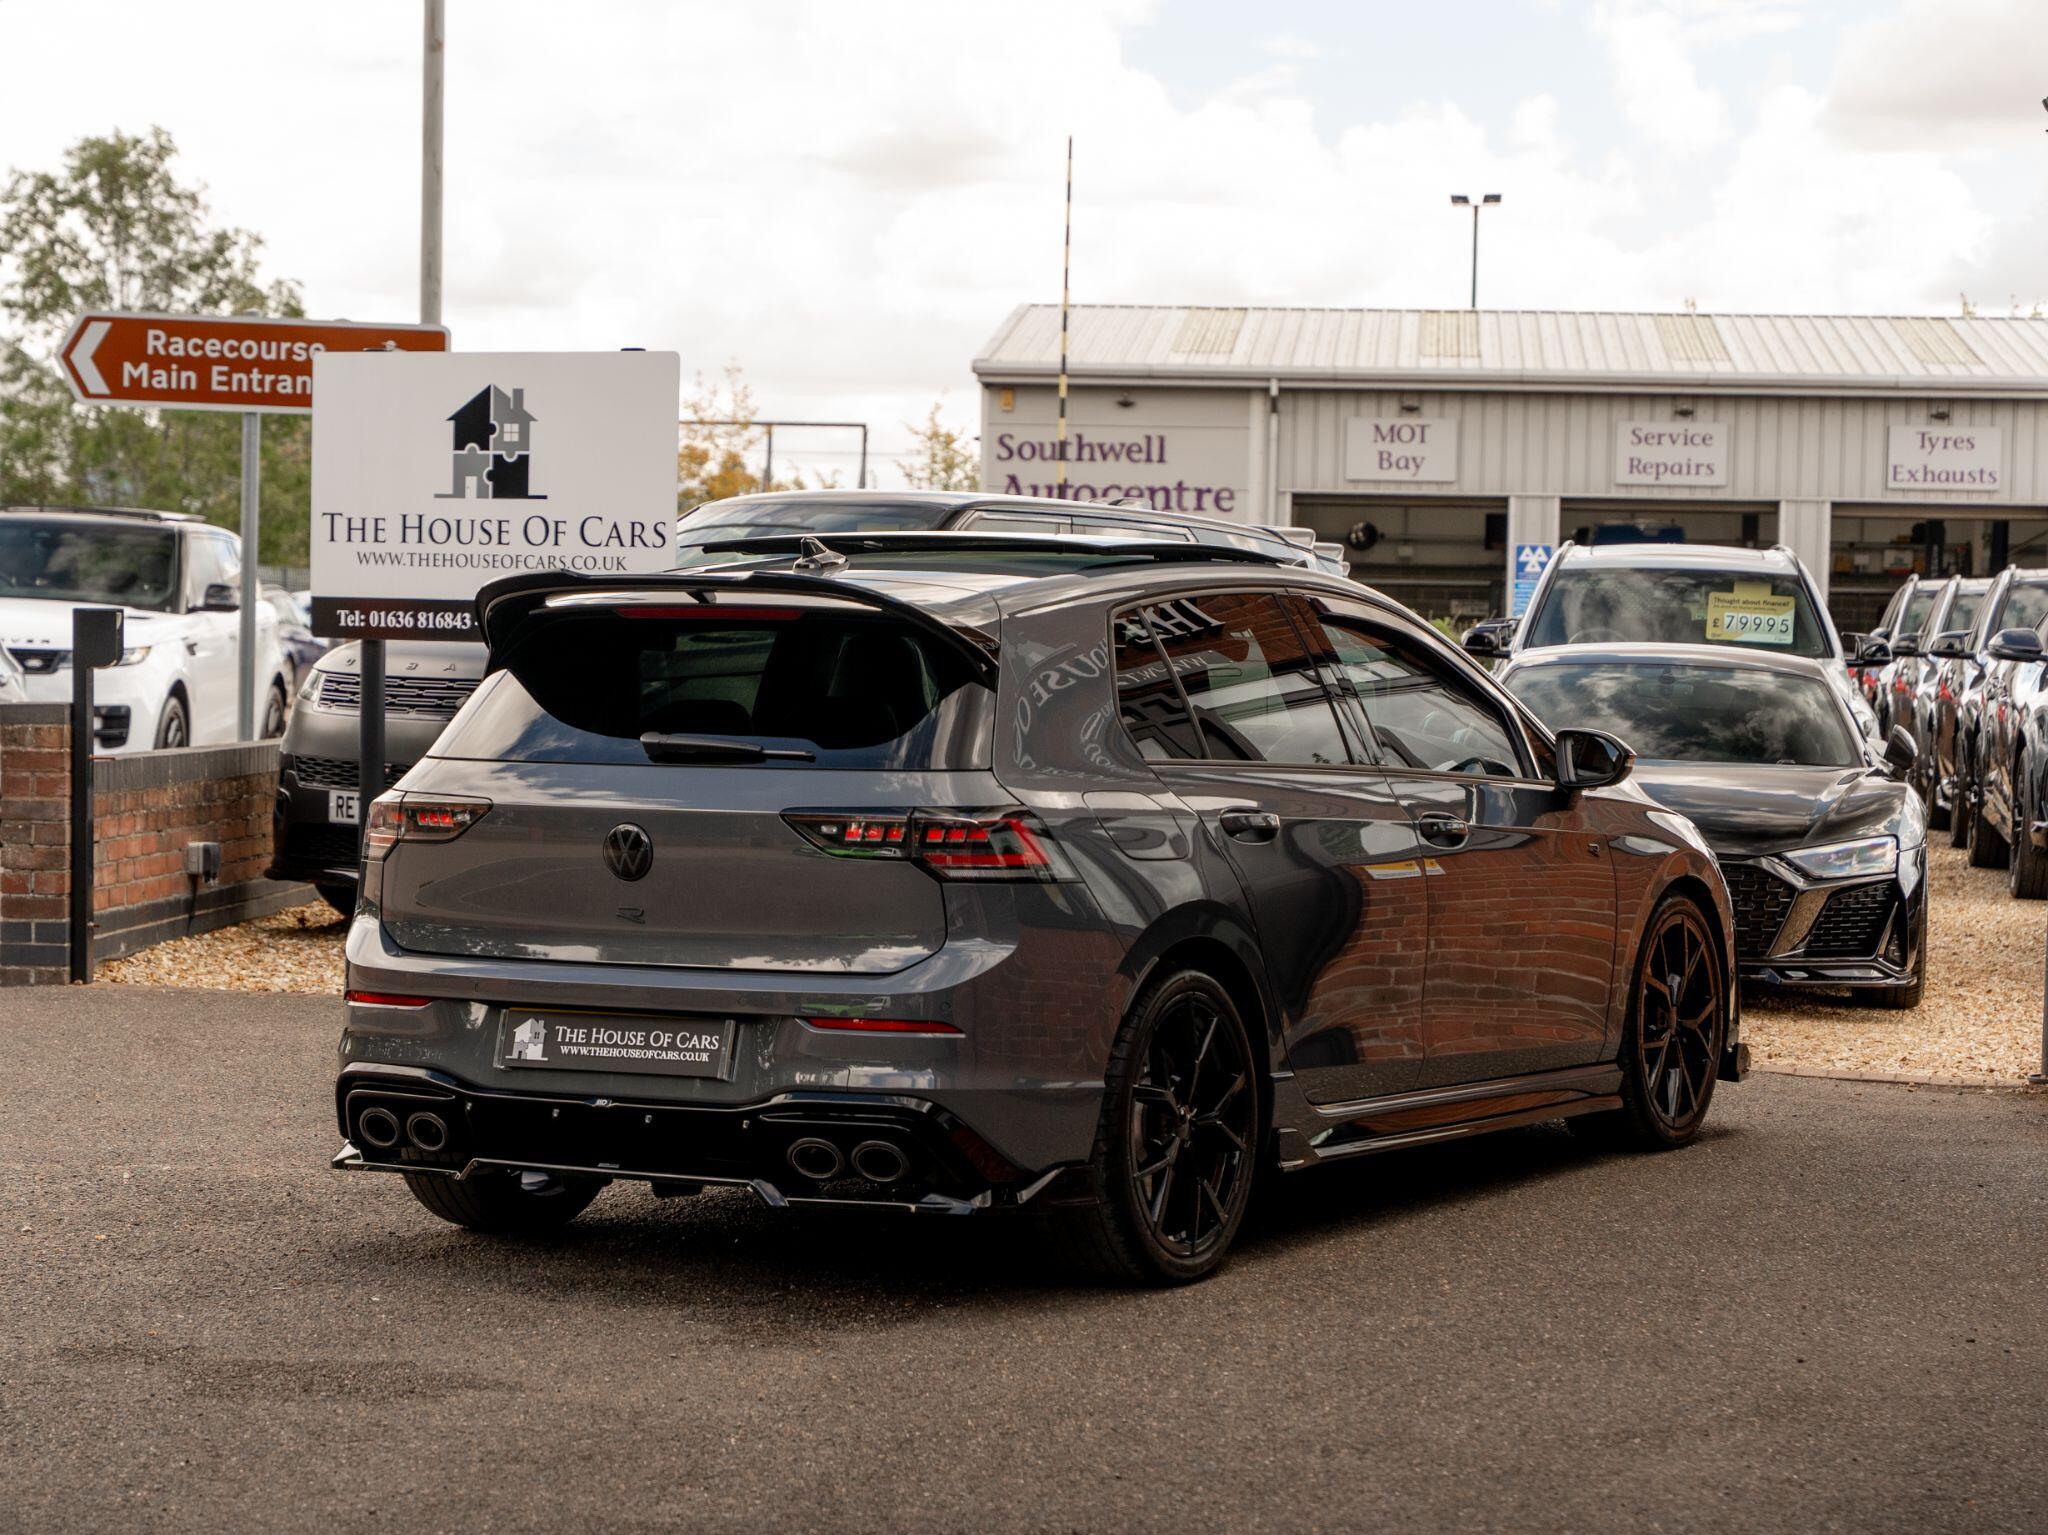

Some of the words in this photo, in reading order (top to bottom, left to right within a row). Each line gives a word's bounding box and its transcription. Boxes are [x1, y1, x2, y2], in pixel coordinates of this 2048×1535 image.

[122, 361, 197, 391] Main
[210, 365, 312, 395] Entran
[1373, 423, 1431, 443] MOT
[1630, 427, 1714, 446] Service
[1916, 431, 1976, 455] Tyres
[996, 432, 1167, 464] Southwell
[1377, 450, 1425, 477] Bay
[1628, 457, 1715, 481] Repairs
[1892, 464, 1998, 484] Exhausts
[321, 512, 387, 543] THE
[400, 513, 510, 546] HOUSE
[522, 515, 567, 546] OF
[579, 516, 667, 549] CARS
[356, 551, 627, 571] WWW.THEHOUSEOFCARS.CO.UK
[336, 609, 367, 627] Tel:
[369, 610, 414, 628] 01636
[417, 611, 472, 630] 816843
[1725, 614, 1789, 633] 79995
[555, 1025, 587, 1044] THE
[591, 1028, 646, 1046] HOUSE
[649, 1030, 672, 1048] OF
[676, 1032, 720, 1050] CARS
[559, 1045, 710, 1062] WWW.THEHOUSEOFCARS.CO.UK
